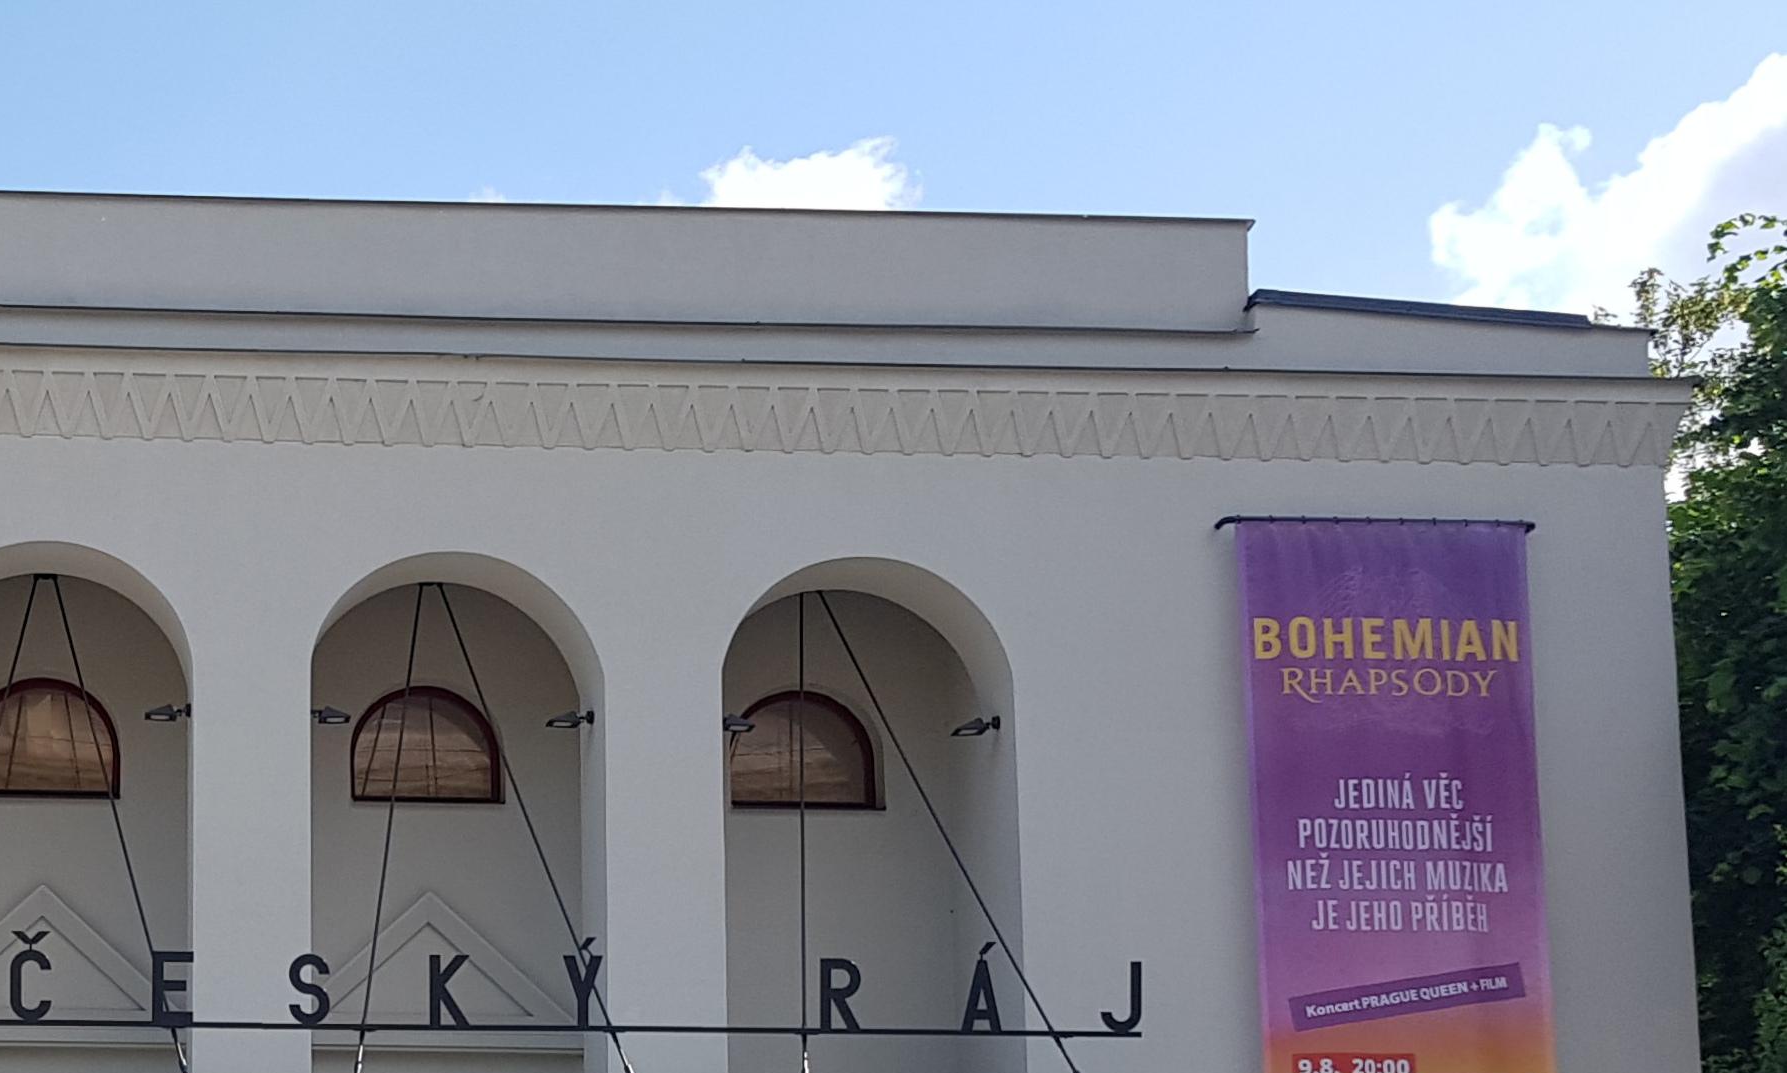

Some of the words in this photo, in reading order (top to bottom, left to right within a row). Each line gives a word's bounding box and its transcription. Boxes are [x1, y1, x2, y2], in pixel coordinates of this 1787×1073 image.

[1253, 616, 1520, 662] BOHEMIAN
[1280, 667, 1497, 703] RHAPSODY
[1334, 772, 1415, 809] JEDINÁ
[1423, 772, 1463, 809] VĚC
[1298, 813, 1493, 852] POZORUHODNĚJŠÍ
[1287, 852, 1332, 890] NEŽ
[1339, 860, 1416, 890] JEJICH
[1426, 860, 1508, 892] MUZIKA
[1312, 900, 1339, 930] JE
[1346, 900, 1403, 931] JEHO
[1411, 894, 1489, 932] PŘÍBĚH
[10, 930, 602, 1028] ČESKÝ
[820, 941, 1142, 1035] RÁJ
[1305, 999, 1362, 1017] Koncert
[1361, 989, 1419, 1009] PRAGUE
[1420, 981, 1469, 1001] QUEEN
[1480, 977, 1508, 991] FILM
